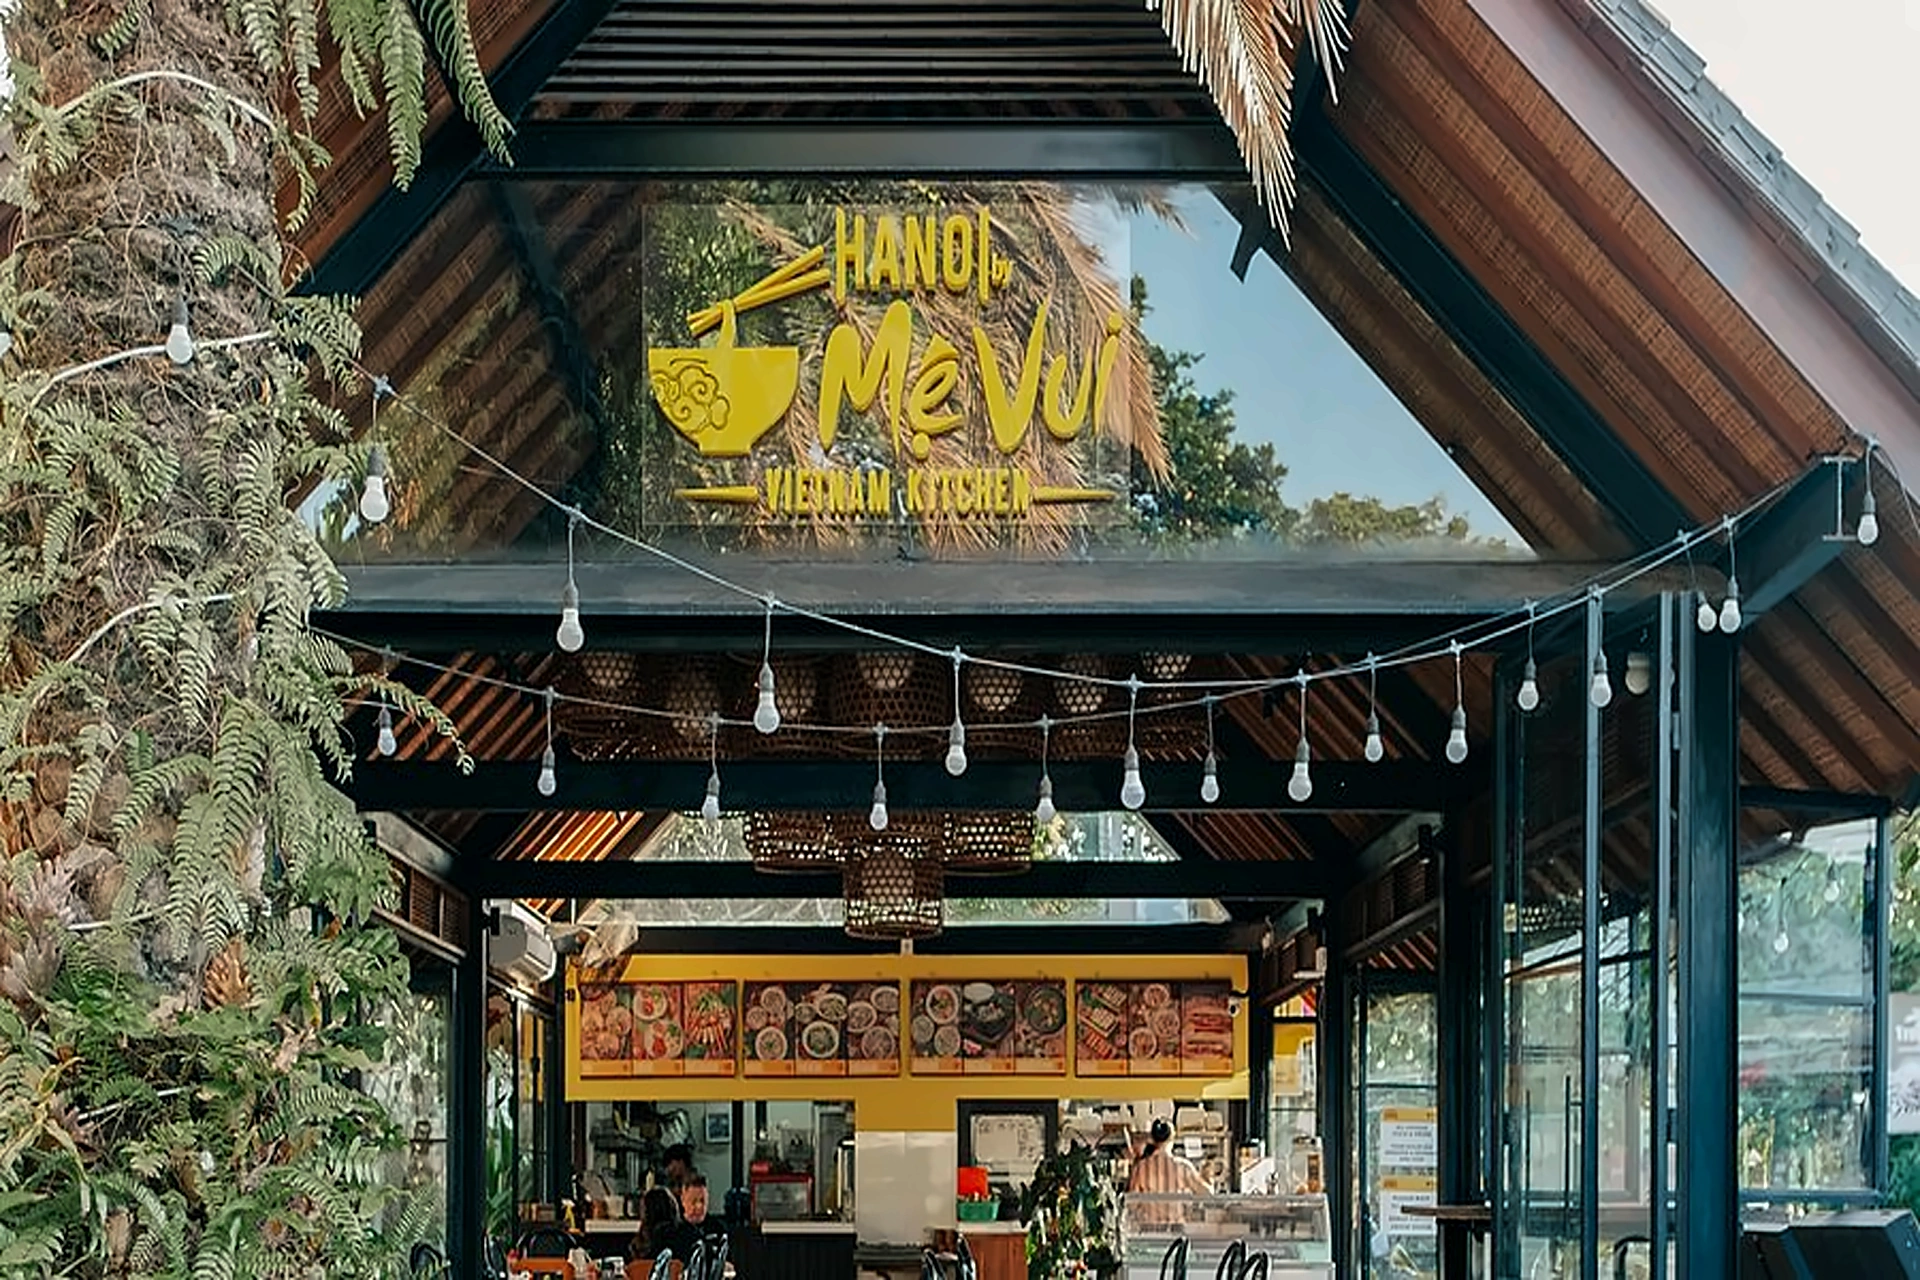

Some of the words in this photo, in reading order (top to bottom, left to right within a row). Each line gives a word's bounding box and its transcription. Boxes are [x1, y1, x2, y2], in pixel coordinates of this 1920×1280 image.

[837, 207, 990, 305] HANOI
[991, 256, 1012, 285] by
[765, 467, 891, 514] VIETNAM
[906, 467, 1031, 514] KITCHEN
